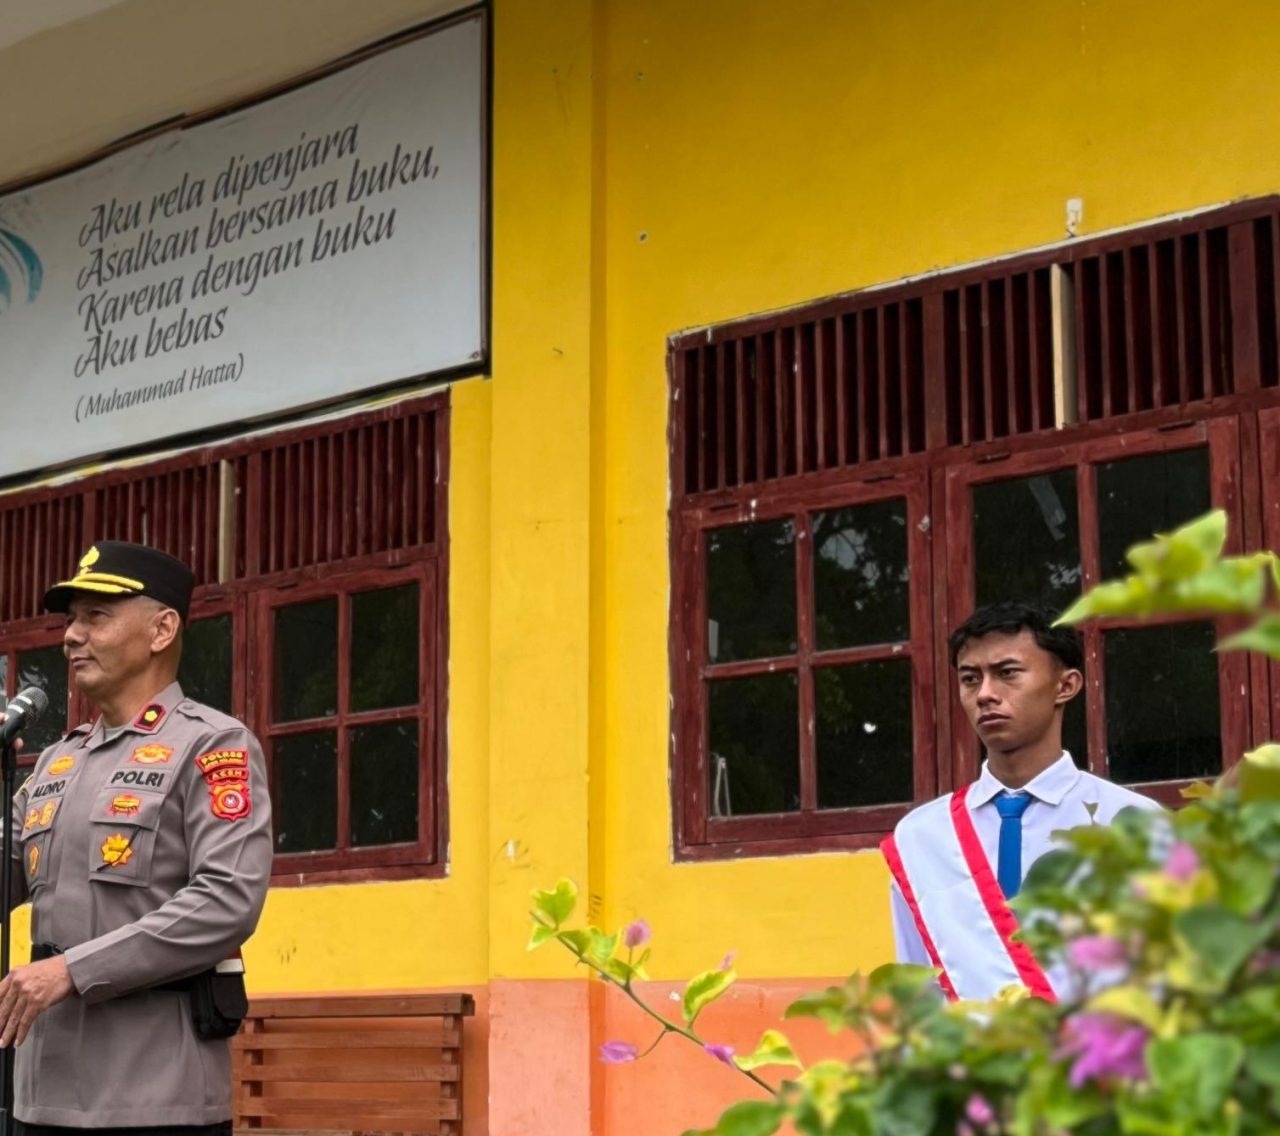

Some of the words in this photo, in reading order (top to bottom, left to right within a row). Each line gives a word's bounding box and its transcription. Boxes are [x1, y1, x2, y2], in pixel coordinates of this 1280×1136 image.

[77, 229, 199, 291] Asalkan
[206, 179, 338, 249] bersama
[347, 144, 439, 203] buku,
[79, 198, 141, 247] Aku
[149, 172, 205, 223] rela
[212, 124, 358, 206] dipenjara
[78, 276, 184, 335] Karena
[191, 254, 304, 298] dengan
[312, 205, 396, 262] buku
[74, 330, 138, 378] Aku
[144, 306, 228, 358] bebas
[189, 353, 244, 391] Hatta)
[32, 780, 66, 799] ALDRO
[111, 771, 165, 788] POLRI
